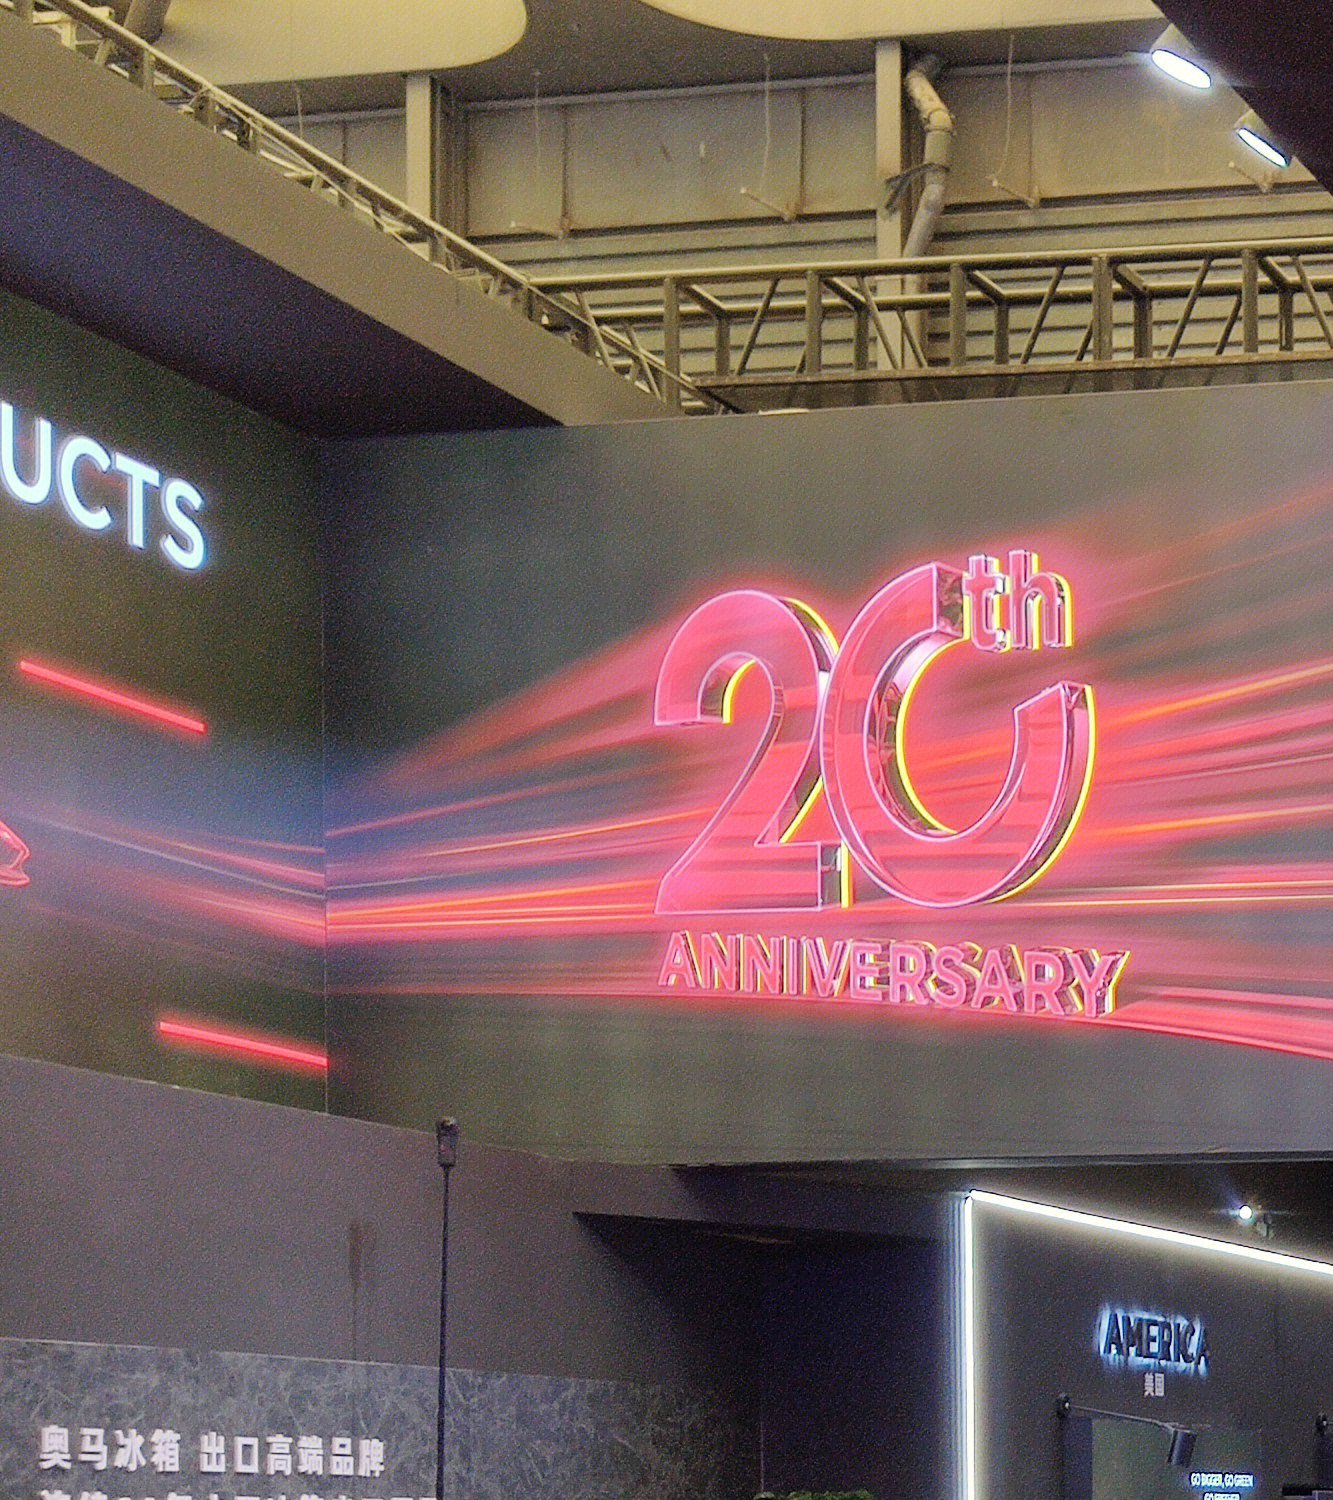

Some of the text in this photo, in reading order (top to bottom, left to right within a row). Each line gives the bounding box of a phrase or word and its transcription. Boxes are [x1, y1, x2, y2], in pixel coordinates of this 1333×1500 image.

[658, 930, 1130, 1018] ANNIVERSARY
[1102, 1311, 1210, 1366] AMERICA
[1144, 1372, 1165, 1397] 美国
[39, 1425, 385, 1477] 奥马冰箱 出口高端品牌
